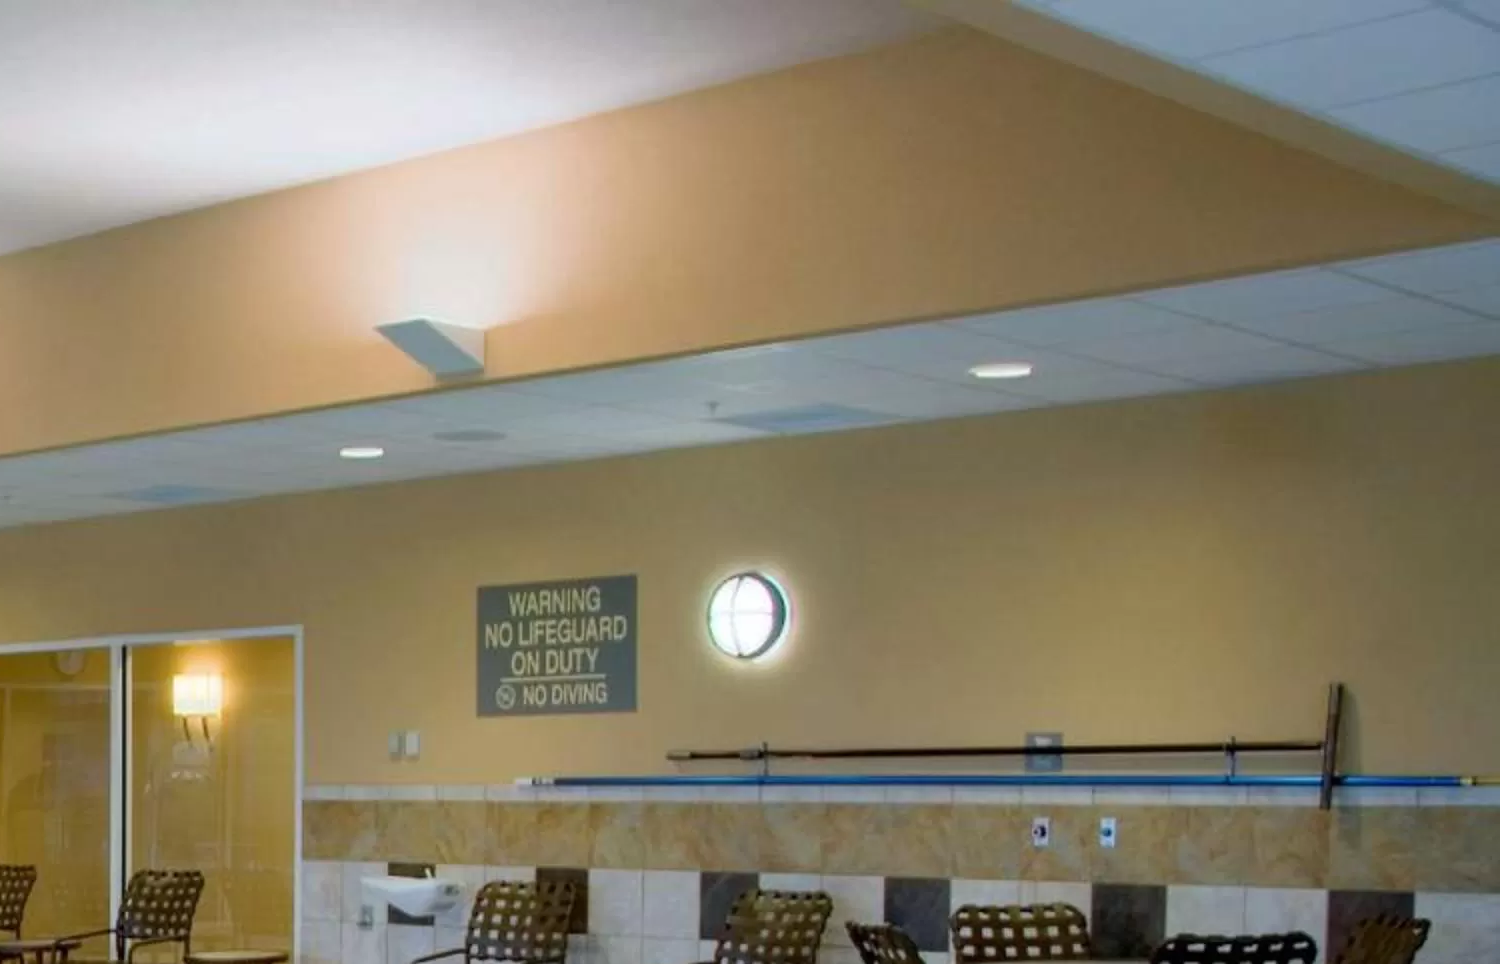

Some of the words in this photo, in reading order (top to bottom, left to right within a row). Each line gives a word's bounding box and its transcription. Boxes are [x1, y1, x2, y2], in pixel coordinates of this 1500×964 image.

[508, 585, 600, 617] WARNING
[485, 621, 513, 649] NO
[518, 615, 628, 647] LIFEGUARD
[511, 651, 539, 676] ON
[545, 647, 599, 674] DUTY
[523, 684, 547, 705] NO
[551, 682, 609, 705] DIVING
